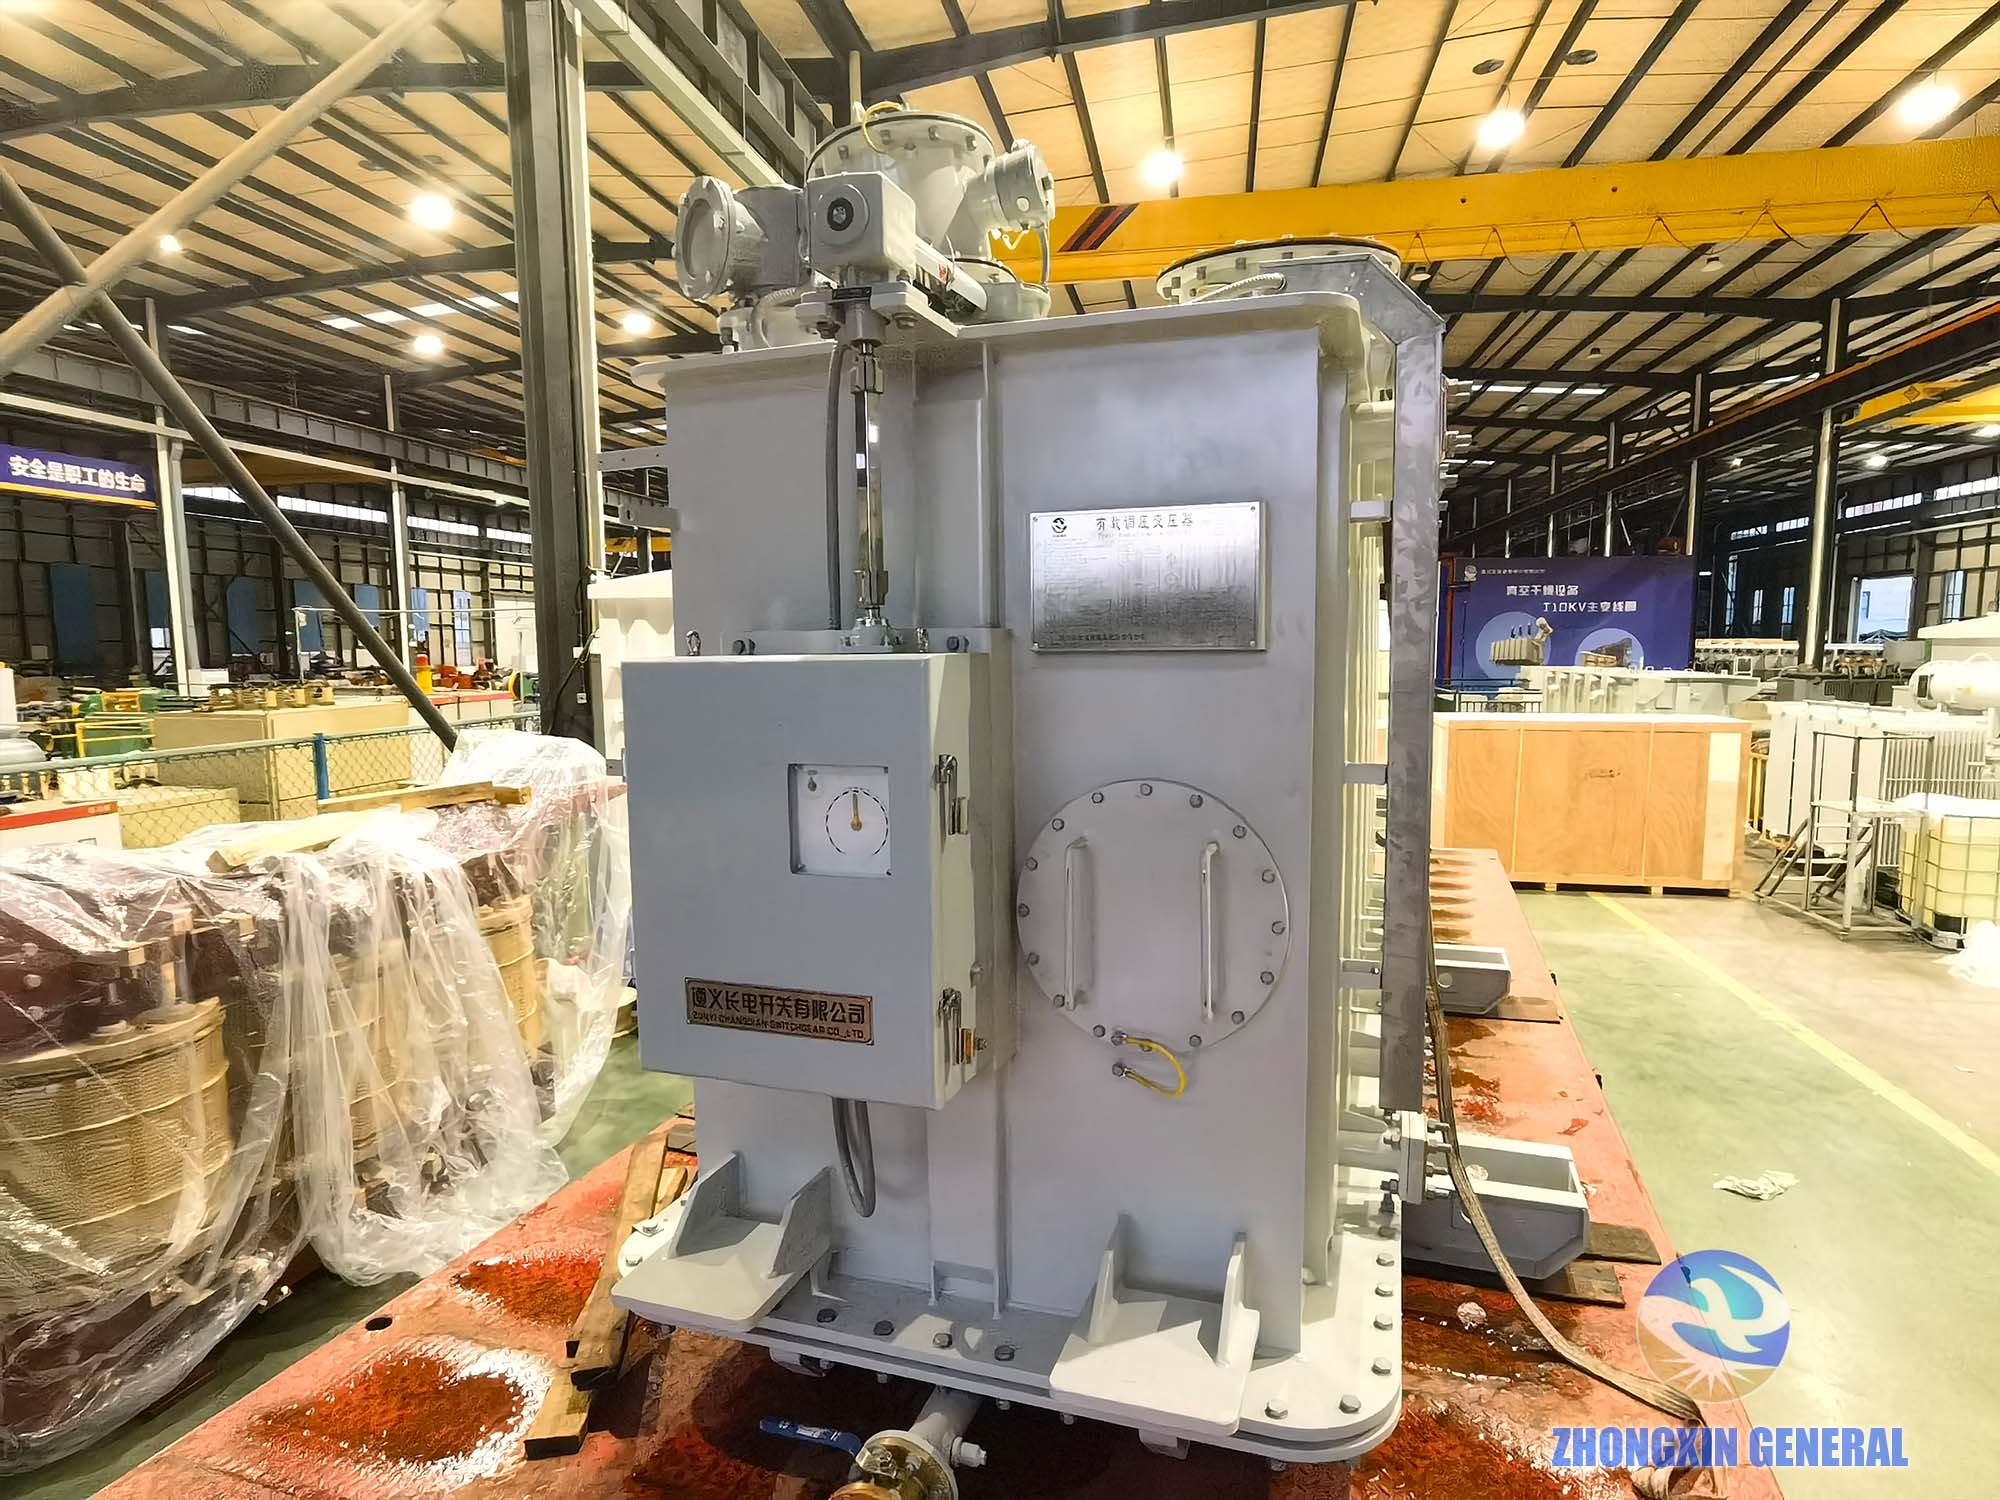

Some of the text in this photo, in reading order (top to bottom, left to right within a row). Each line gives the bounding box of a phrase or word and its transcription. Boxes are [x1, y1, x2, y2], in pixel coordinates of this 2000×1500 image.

[8, 454, 146, 493] 安全是职工的生命
[691, 986, 865, 1025] 遵义长电开关有限公司
